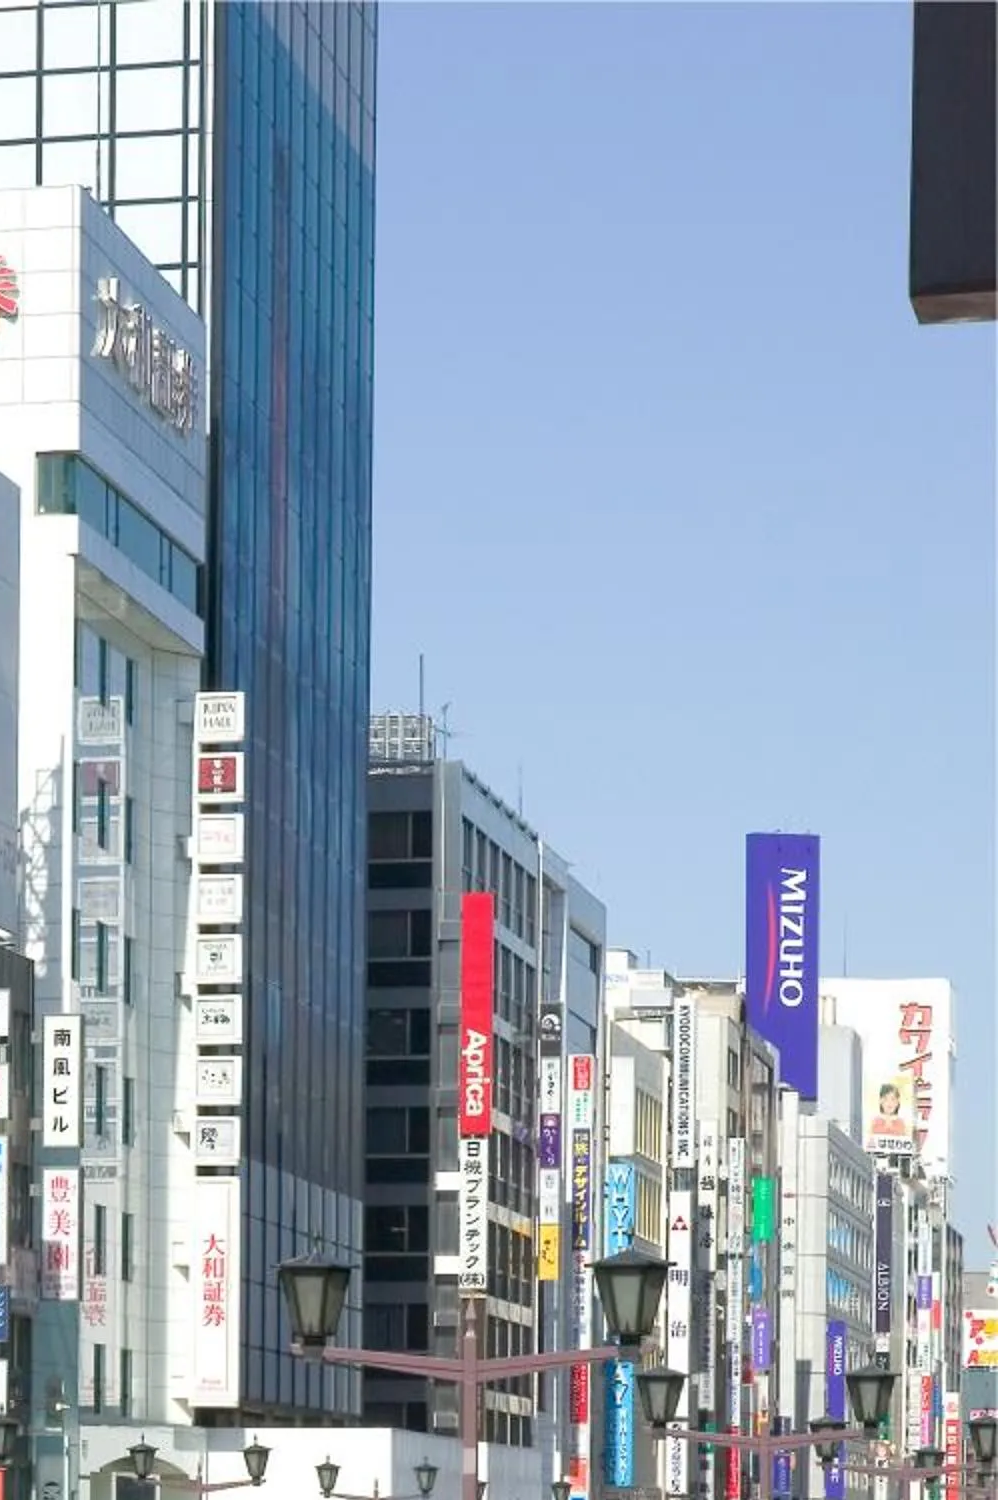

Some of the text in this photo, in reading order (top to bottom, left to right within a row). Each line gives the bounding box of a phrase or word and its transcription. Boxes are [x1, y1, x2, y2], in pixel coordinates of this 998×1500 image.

[779, 867, 807, 1008] MIZUHO
[52, 1028, 71, 1134] 南風ビル
[464, 1029, 491, 1117] Aprica
[202, 1233, 226, 1327] 大和証券
[669, 1268, 689, 1338] 明治
[877, 1263, 890, 1312] ALBION
